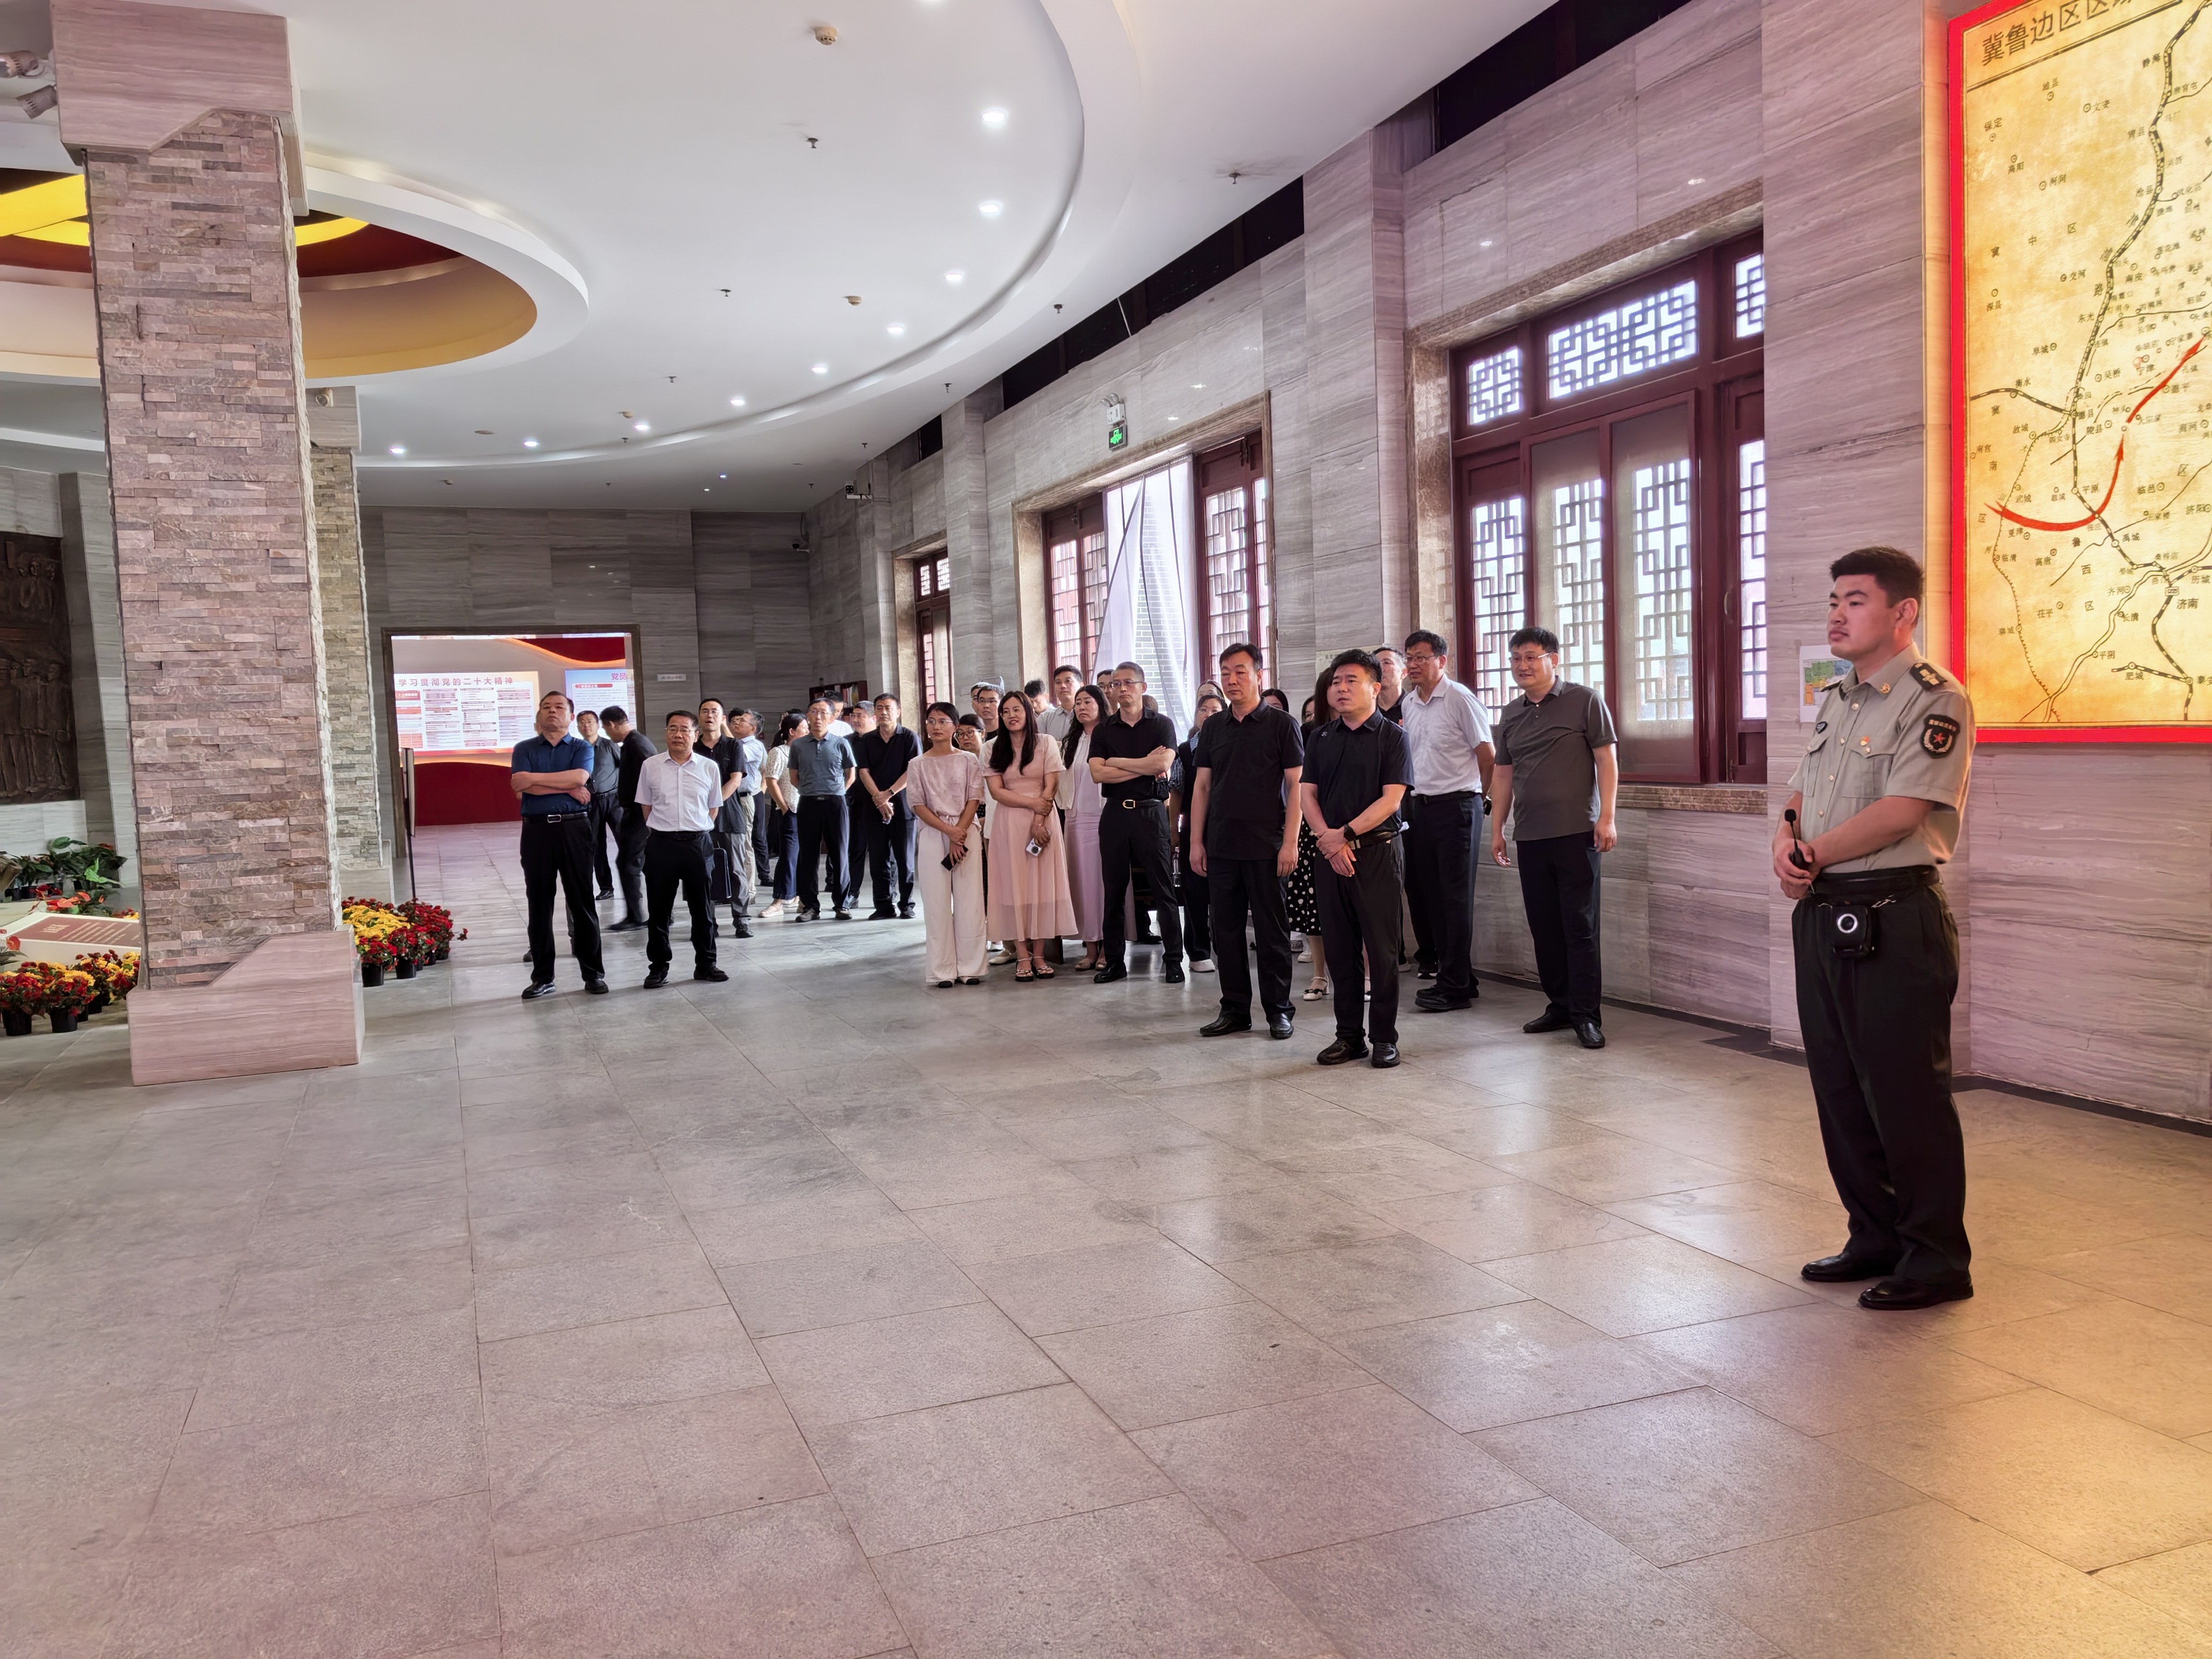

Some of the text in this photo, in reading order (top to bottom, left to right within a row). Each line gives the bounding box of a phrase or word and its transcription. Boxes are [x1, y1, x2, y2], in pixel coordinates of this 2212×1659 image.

[1982, 0, 2130, 66] 冀鲁边区区
[1984, 117, 2002, 132] 保定
[2028, 235, 2036, 246] 中
[2067, 222, 2076, 234] 区
[2078, 312, 2095, 323] 东光
[2015, 377, 2031, 388] 衡水
[2013, 423, 2029, 434] 故城
[2049, 434, 2071, 444] 四女寺
[1989, 461, 1998, 471] 南
[2177, 463, 2189, 477] 区
[2137, 484, 2156, 495] 临邑
[2015, 494, 2032, 503] 武城
[1978, 513, 1987, 523] 区
[2007, 527, 2024, 538] 夏津
[2122, 532, 2140, 543] 禹城
[2001, 554, 2017, 563] 临清
[2035, 556, 2052, 567] 高唐
[2081, 564, 2092, 576] 西
[2085, 601, 2094, 612] 区
[2176, 598, 2199, 610] 济南
[2122, 612, 2139, 622] 长清
[2099, 650, 2116, 660] 平阴
[399, 676, 514, 687] 学习贯彻党的二十大精神
[2125, 671, 2144, 681] 肥城
